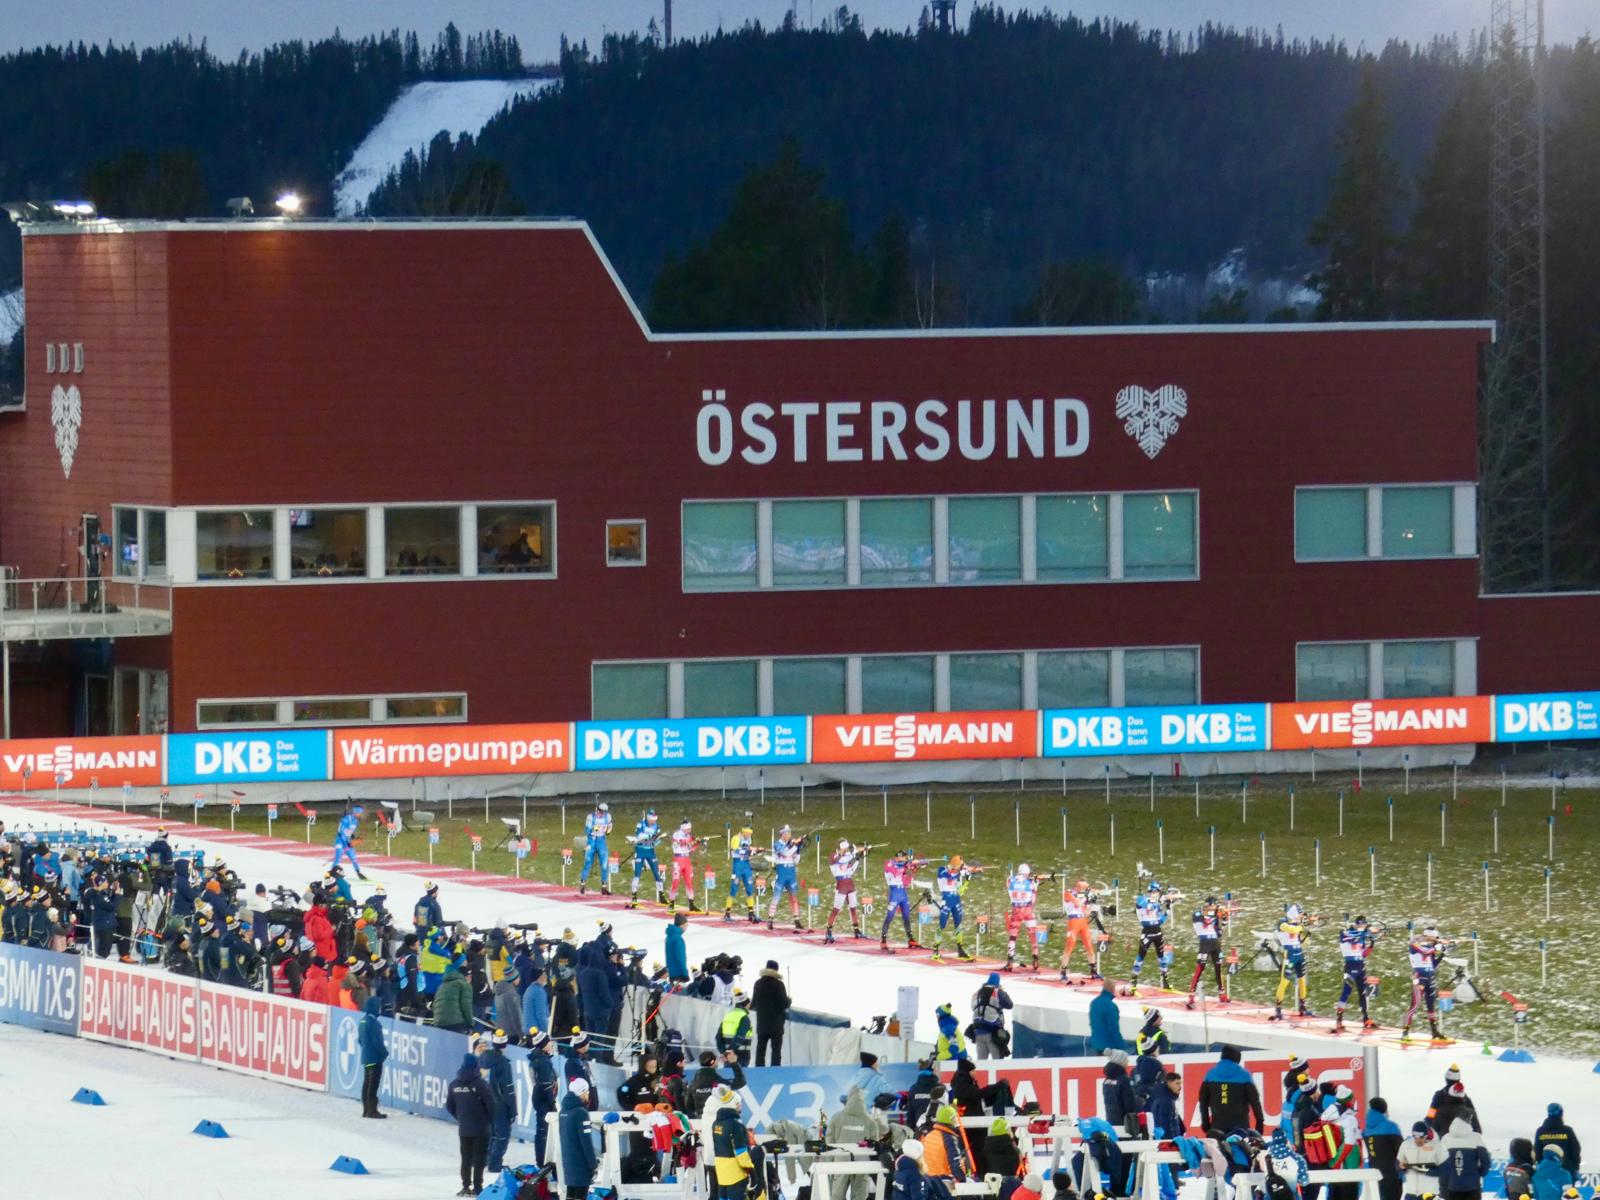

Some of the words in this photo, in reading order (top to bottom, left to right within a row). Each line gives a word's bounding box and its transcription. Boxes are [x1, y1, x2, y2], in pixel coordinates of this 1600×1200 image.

[696, 389, 1090, 466] ÖSTERSUND
[775, 725, 792, 735] Das
[1052, 716, 1123, 748] DKB
[1127, 716, 1143, 726] Das
[1161, 713, 1232, 745] DKB
[1235, 713, 1251, 722] Das
[1293, 702, 1467, 745] VIESSMANN
[1503, 701, 1574, 733] DKB
[276, 740, 294, 750] Das
[585, 728, 659, 760] DKB
[663, 728, 680, 738] Das
[697, 725, 771, 757] DKB
[836, 715, 1013, 758] VIESSMANN
[1127, 736, 1148, 746] Bank
[1235, 733, 1256, 743] Bank
[3, 745, 157, 782] VIESSMANN
[195, 741, 273, 774] DKB
[341, 738, 562, 768] Wärmepumpen
[663, 748, 685, 758] Bank
[775, 745, 797, 755] Bank
[276, 762, 299, 772] Bank
[757, 886, 767, 896] 12
[862, 904, 872, 915] 10
[979, 922, 986, 934] 8
[1099, 941, 1106, 952] 6
[0, 957, 42, 1014] BMW
[44, 964, 76, 1020] iX3
[1369, 984, 1377, 996] 2
[82, 975, 195, 1044] BAUHAUS
[201, 1000, 324, 1073] BAUHAUS
[391, 1030, 428, 1068] FIRST
[393, 1067, 422, 1104] NEW
